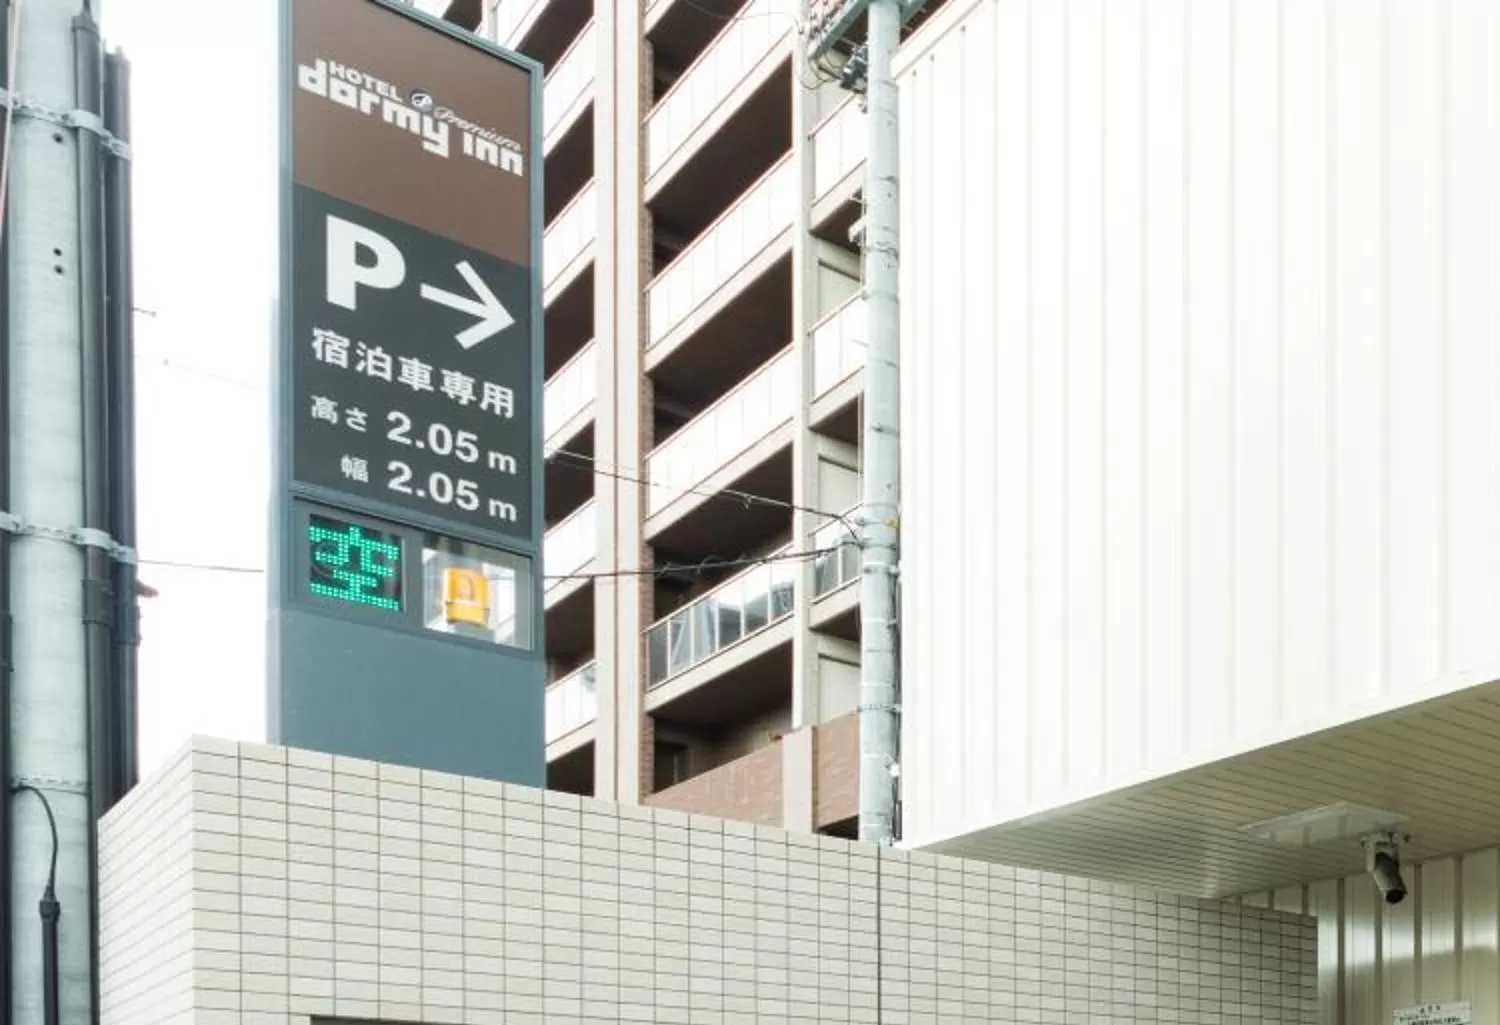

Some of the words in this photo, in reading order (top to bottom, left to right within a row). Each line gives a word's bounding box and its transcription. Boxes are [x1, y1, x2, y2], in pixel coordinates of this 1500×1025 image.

[297, 58, 449, 158] dormy
[463, 131, 523, 176] inn
[329, 60, 402, 102] HOTEL
[326, 214, 406, 312] P
[311, 327, 514, 419] 宿泊車専用
[310, 395, 368, 432] 高さ
[386, 410, 479, 463] 2.05
[488, 451, 517, 474] m
[340, 454, 368, 483] 幅
[387, 460, 480, 511] 2.05
[489, 498, 517, 522] m
[308, 525, 399, 611] 空
